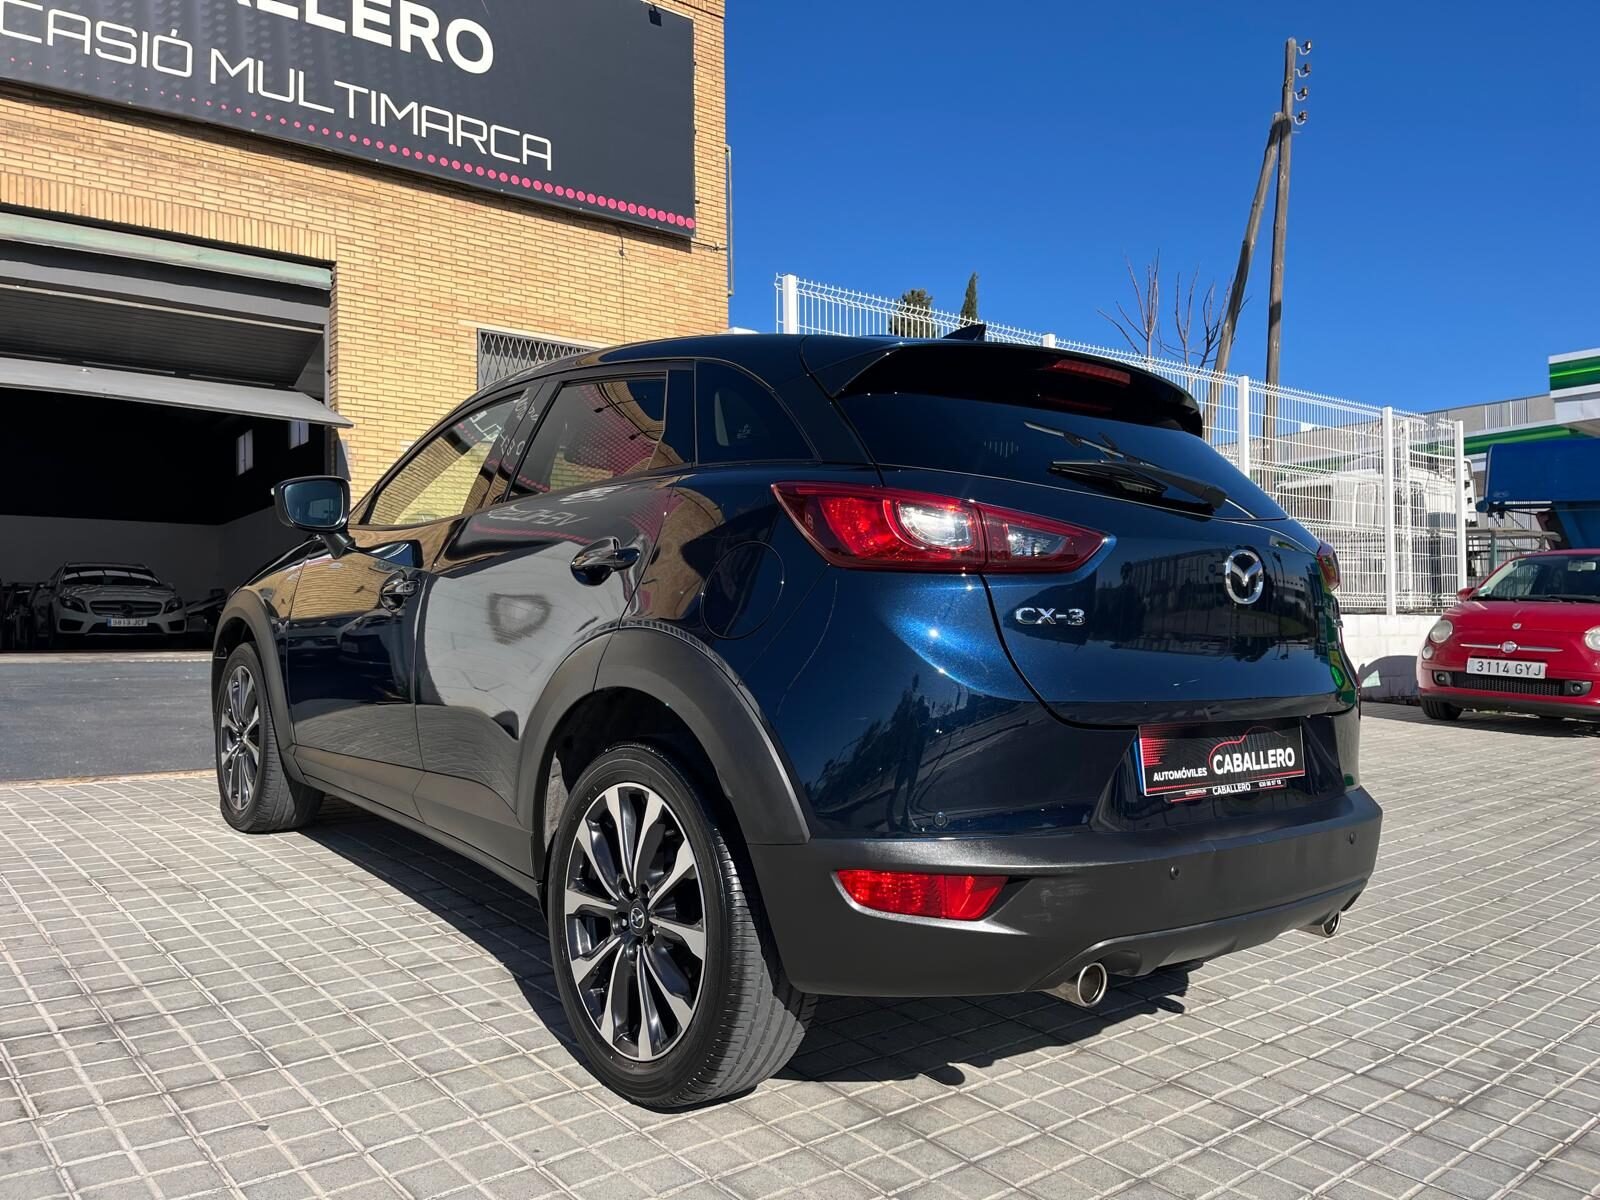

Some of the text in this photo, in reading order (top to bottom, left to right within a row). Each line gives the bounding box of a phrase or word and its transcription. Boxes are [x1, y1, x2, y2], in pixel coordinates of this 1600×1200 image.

[210, 48, 552, 171] MULTIMARCA
[1015, 607, 1086, 626] CX-3
[1476, 660, 1542, 676] 3114 GYJ
[1153, 747, 1295, 781] AUTOMÓVILES CABALLERO
[1212, 782, 1251, 796] CABALLERO
